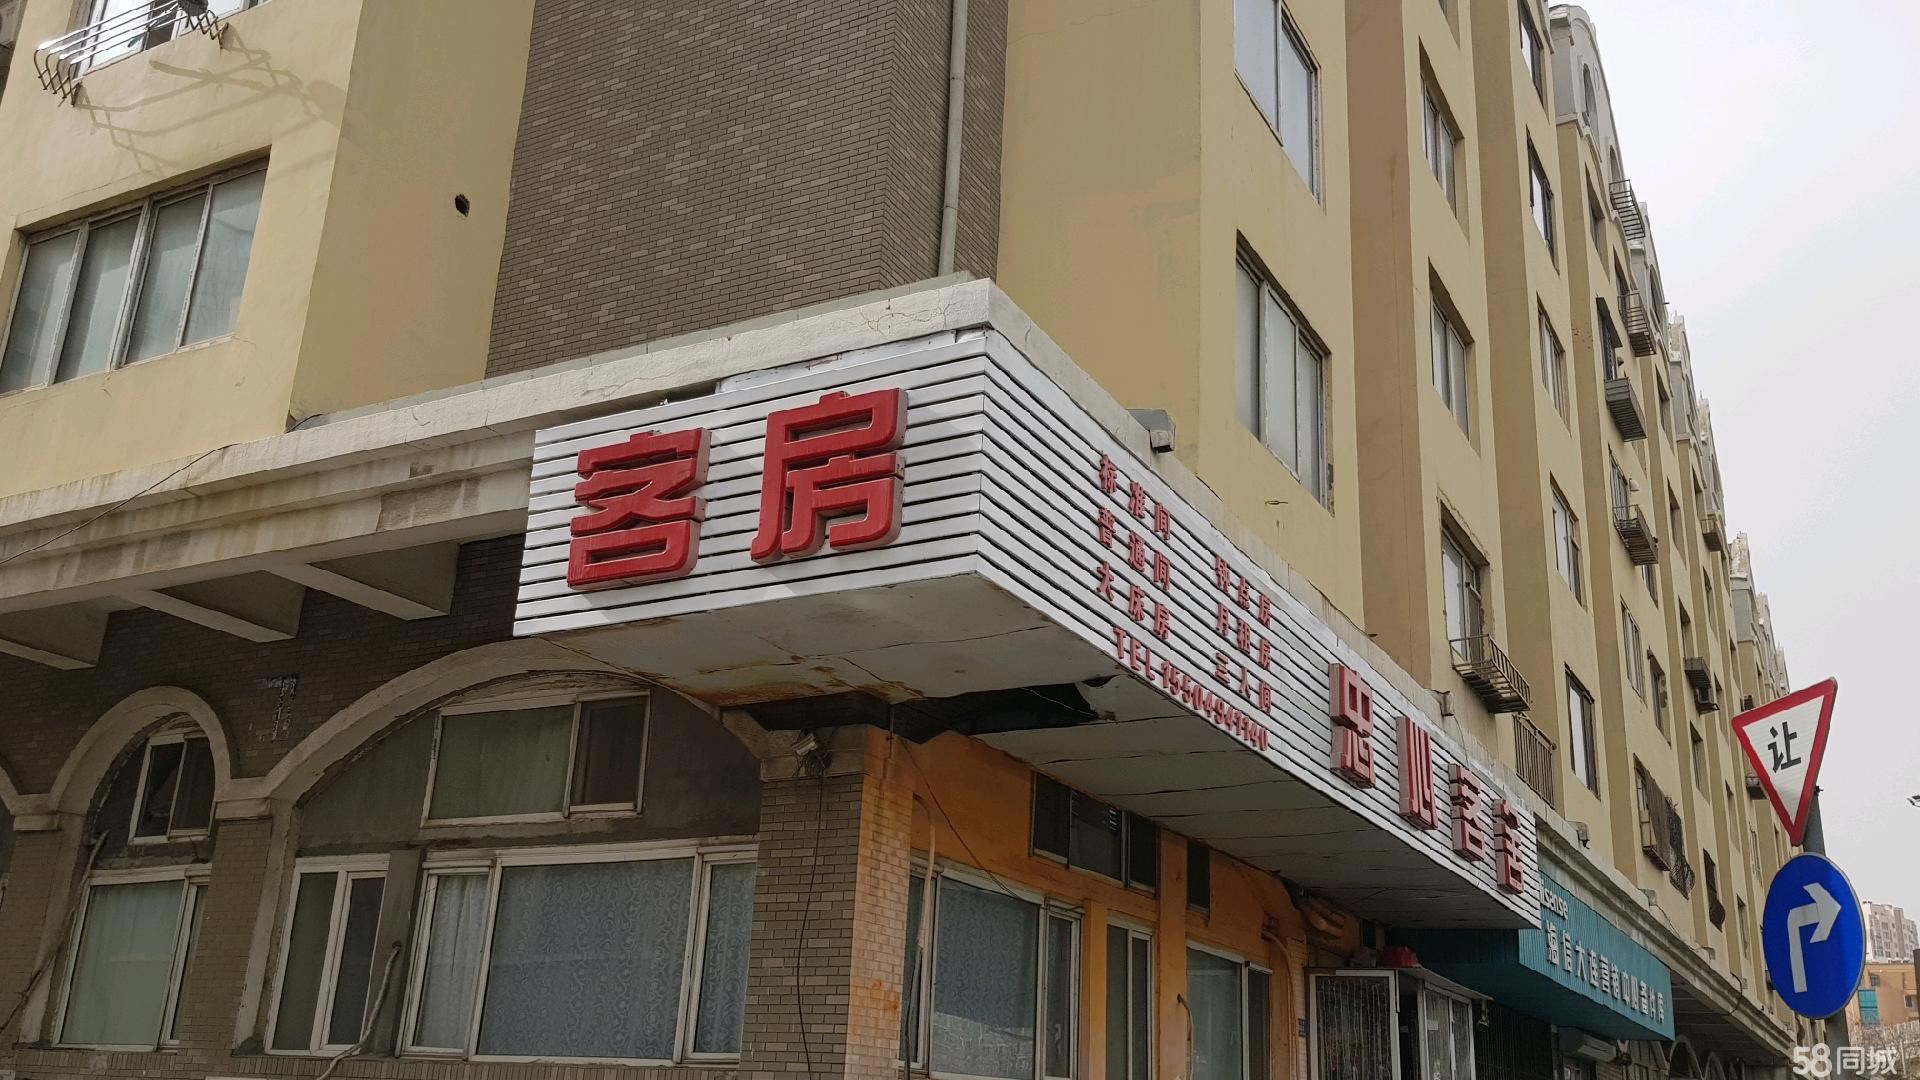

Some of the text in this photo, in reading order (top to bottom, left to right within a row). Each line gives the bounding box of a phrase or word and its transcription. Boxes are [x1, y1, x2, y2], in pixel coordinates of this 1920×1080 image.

[567, 388, 908, 590] 客房
[1099, 454, 1171, 540] 标准间
[1098, 507, 1171, 591] 普通间
[1096, 561, 1170, 640] 大床房
[1215, 554, 1270, 629] 钟点房
[1215, 652, 1271, 715] 三人间
[1767, 721, 1802, 773] 让
[1540, 877, 1569, 920] isense
